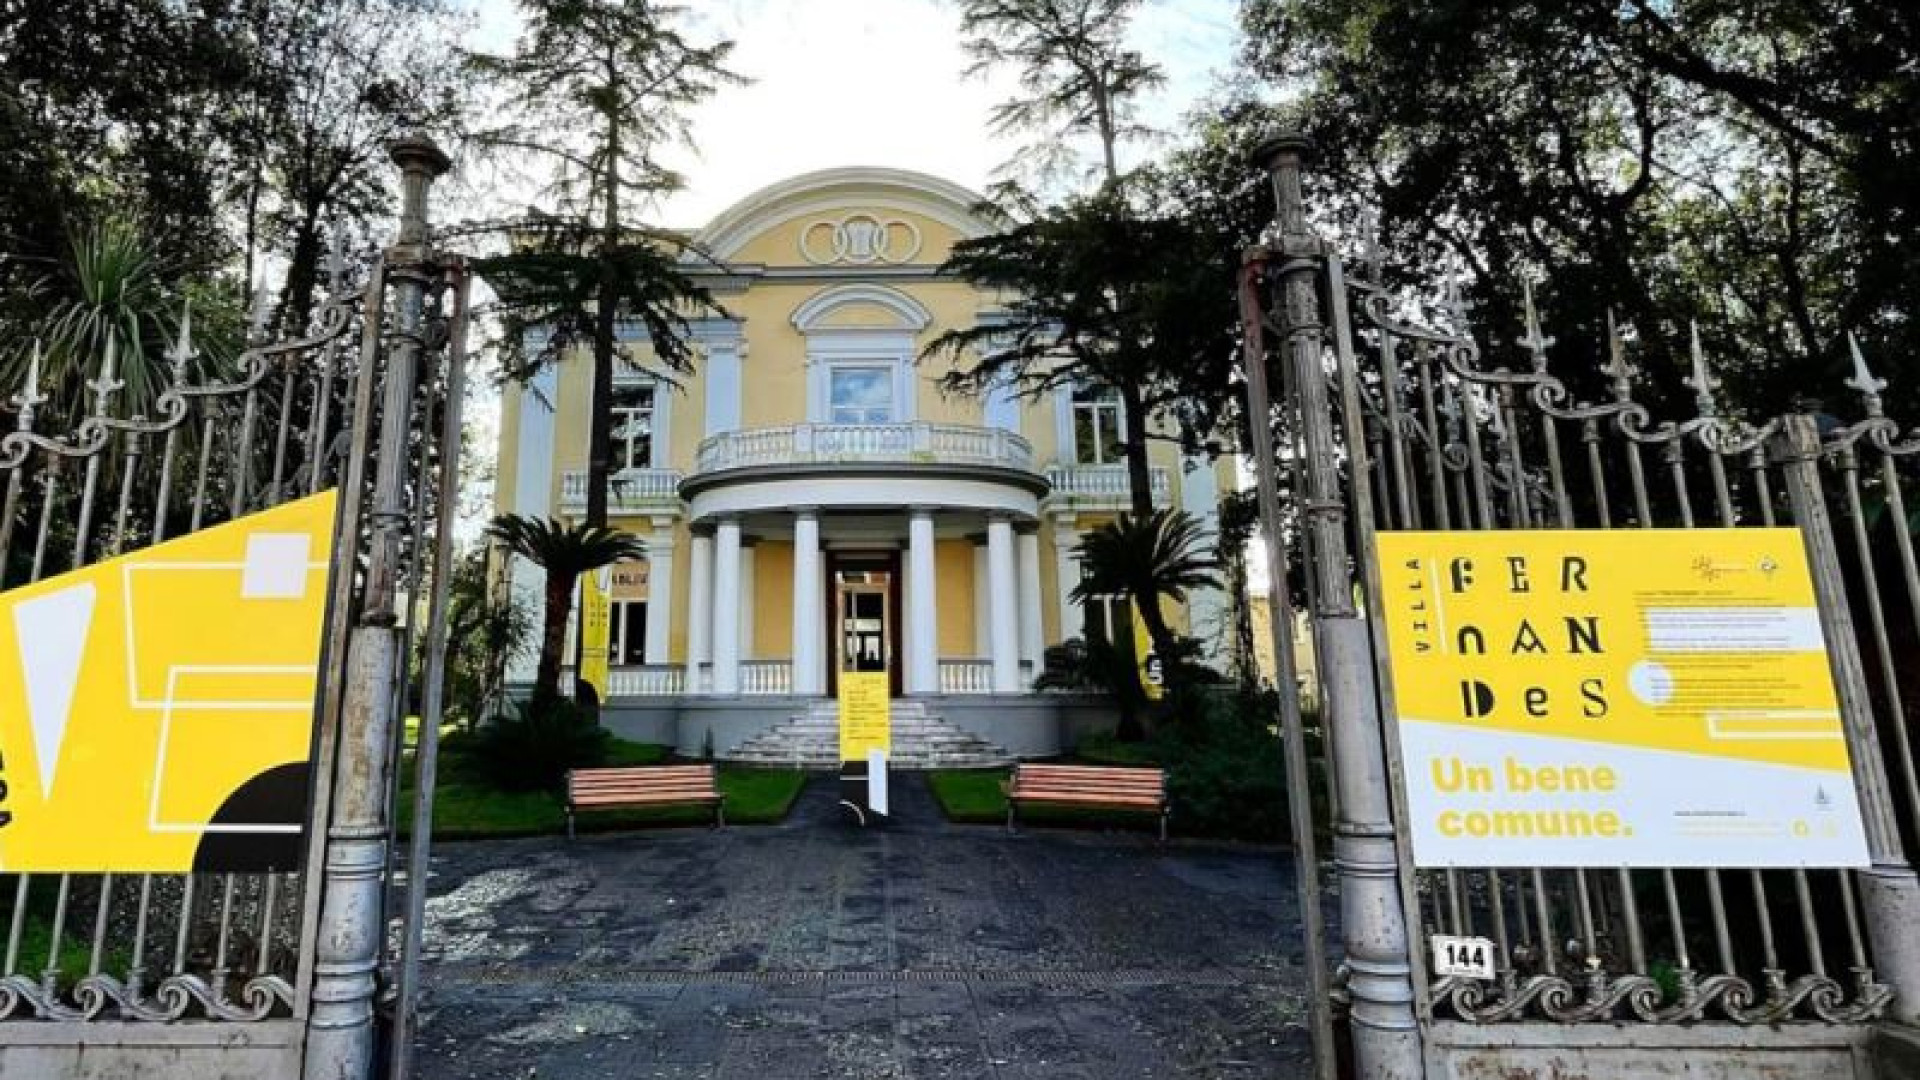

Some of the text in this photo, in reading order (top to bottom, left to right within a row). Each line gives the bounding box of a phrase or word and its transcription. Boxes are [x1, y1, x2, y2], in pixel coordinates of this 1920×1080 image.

[1405, 558, 1431, 652] VILLA
[1431, 755, 1617, 793] Un bene
[1436, 809, 1634, 838] comune.
[1446, 944, 1485, 968] 144
